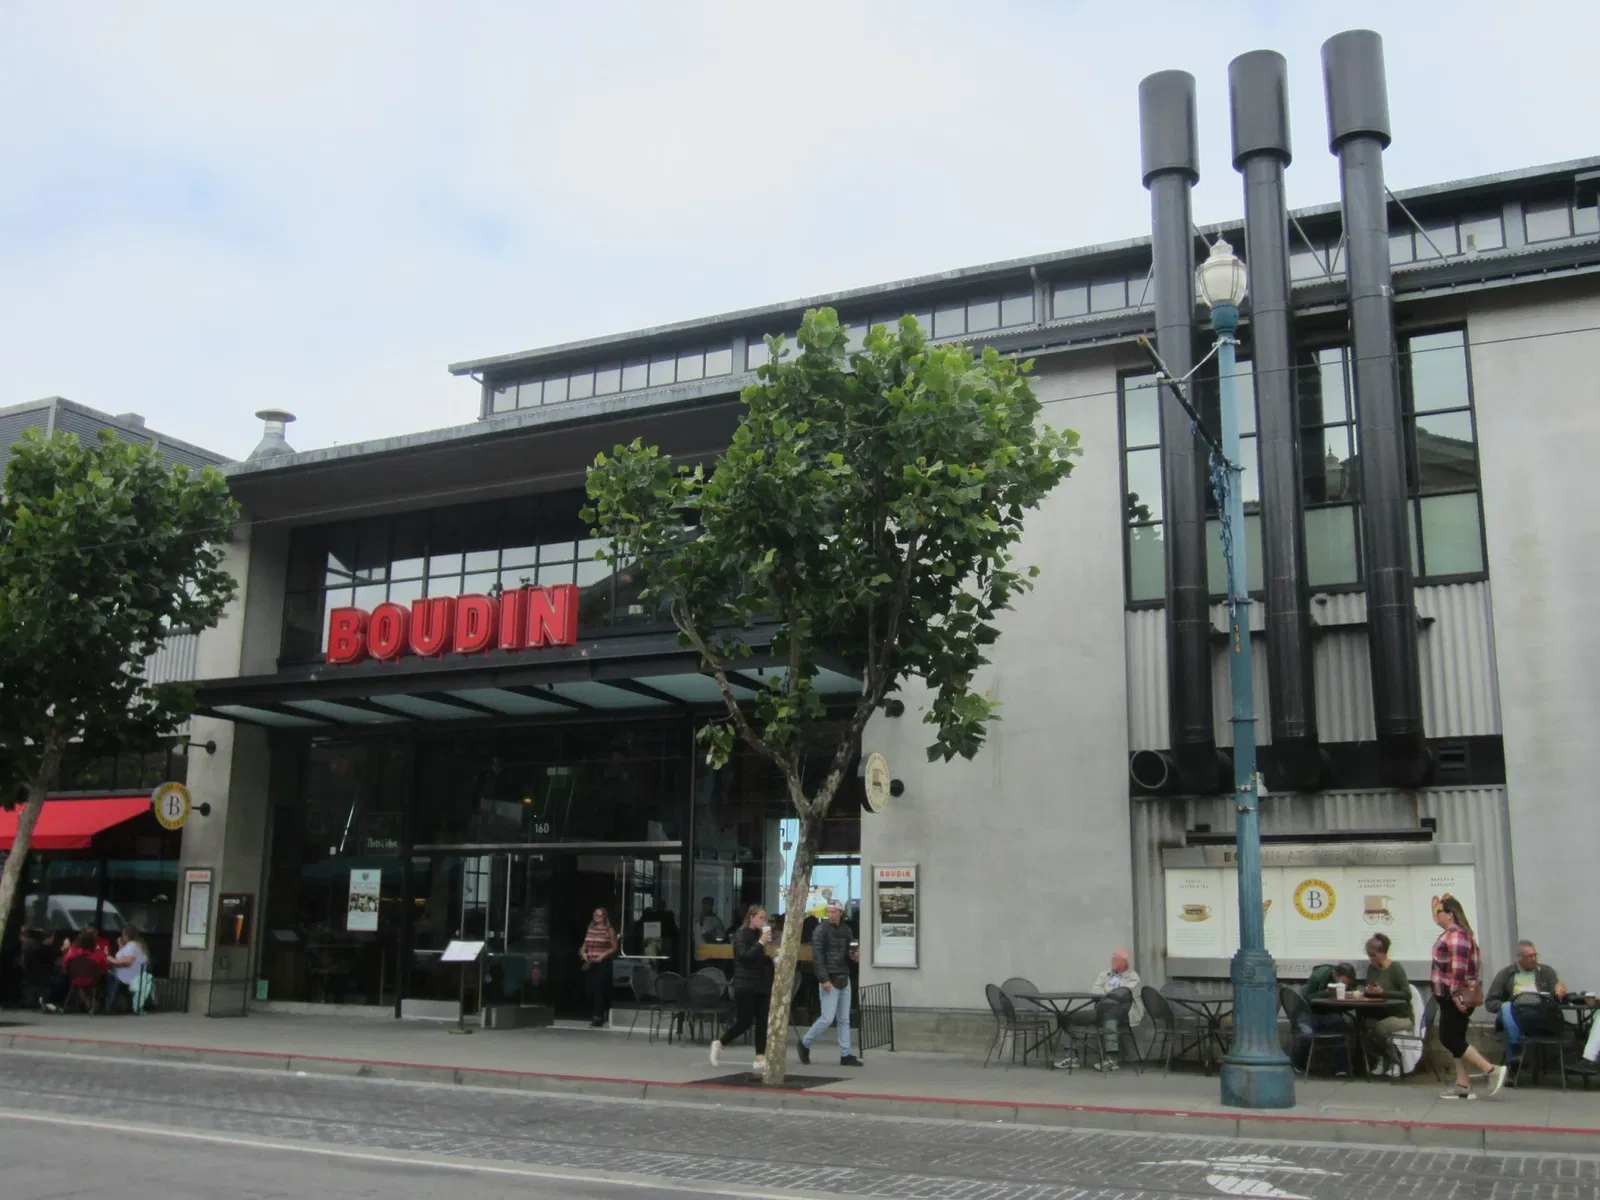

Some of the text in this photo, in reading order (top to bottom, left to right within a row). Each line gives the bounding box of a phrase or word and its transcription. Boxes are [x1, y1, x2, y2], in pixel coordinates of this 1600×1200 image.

[327, 584, 578, 664] BOUDIN
[166, 795, 180, 816] B
[534, 823, 550, 834] 160
[879, 870, 912, 878] BOUDIN
[1306, 890, 1322, 909] B
